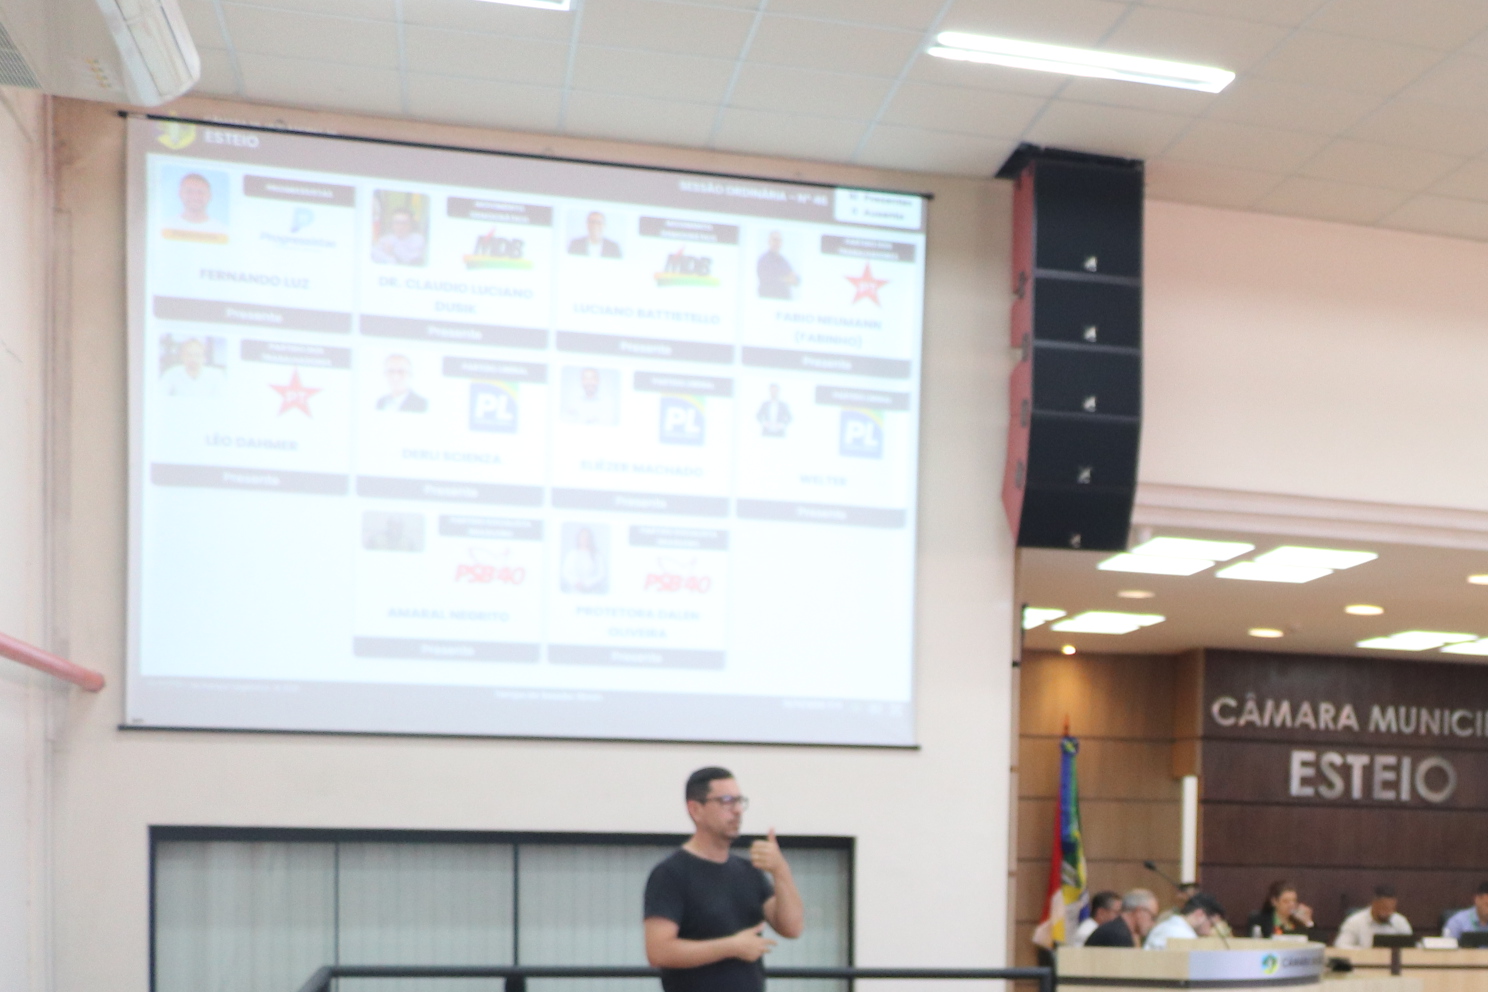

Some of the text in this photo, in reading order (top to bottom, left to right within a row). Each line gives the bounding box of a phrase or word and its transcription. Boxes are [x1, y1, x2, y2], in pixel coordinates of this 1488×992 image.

[204, 131, 260, 148] ESTEIO
[473, 233, 526, 259] MDB
[663, 252, 714, 277] MDB
[199, 268, 310, 290] FERNANDO LUZ
[470, 283, 534, 299] LUCIANO
[573, 302, 634, 318] LUCIANO
[474, 393, 514, 421] PL
[665, 406, 701, 433] PL
[845, 421, 879, 447] PL
[1212, 693, 1359, 732] CÂMARA
[1289, 749, 1456, 804] ESTEIO
